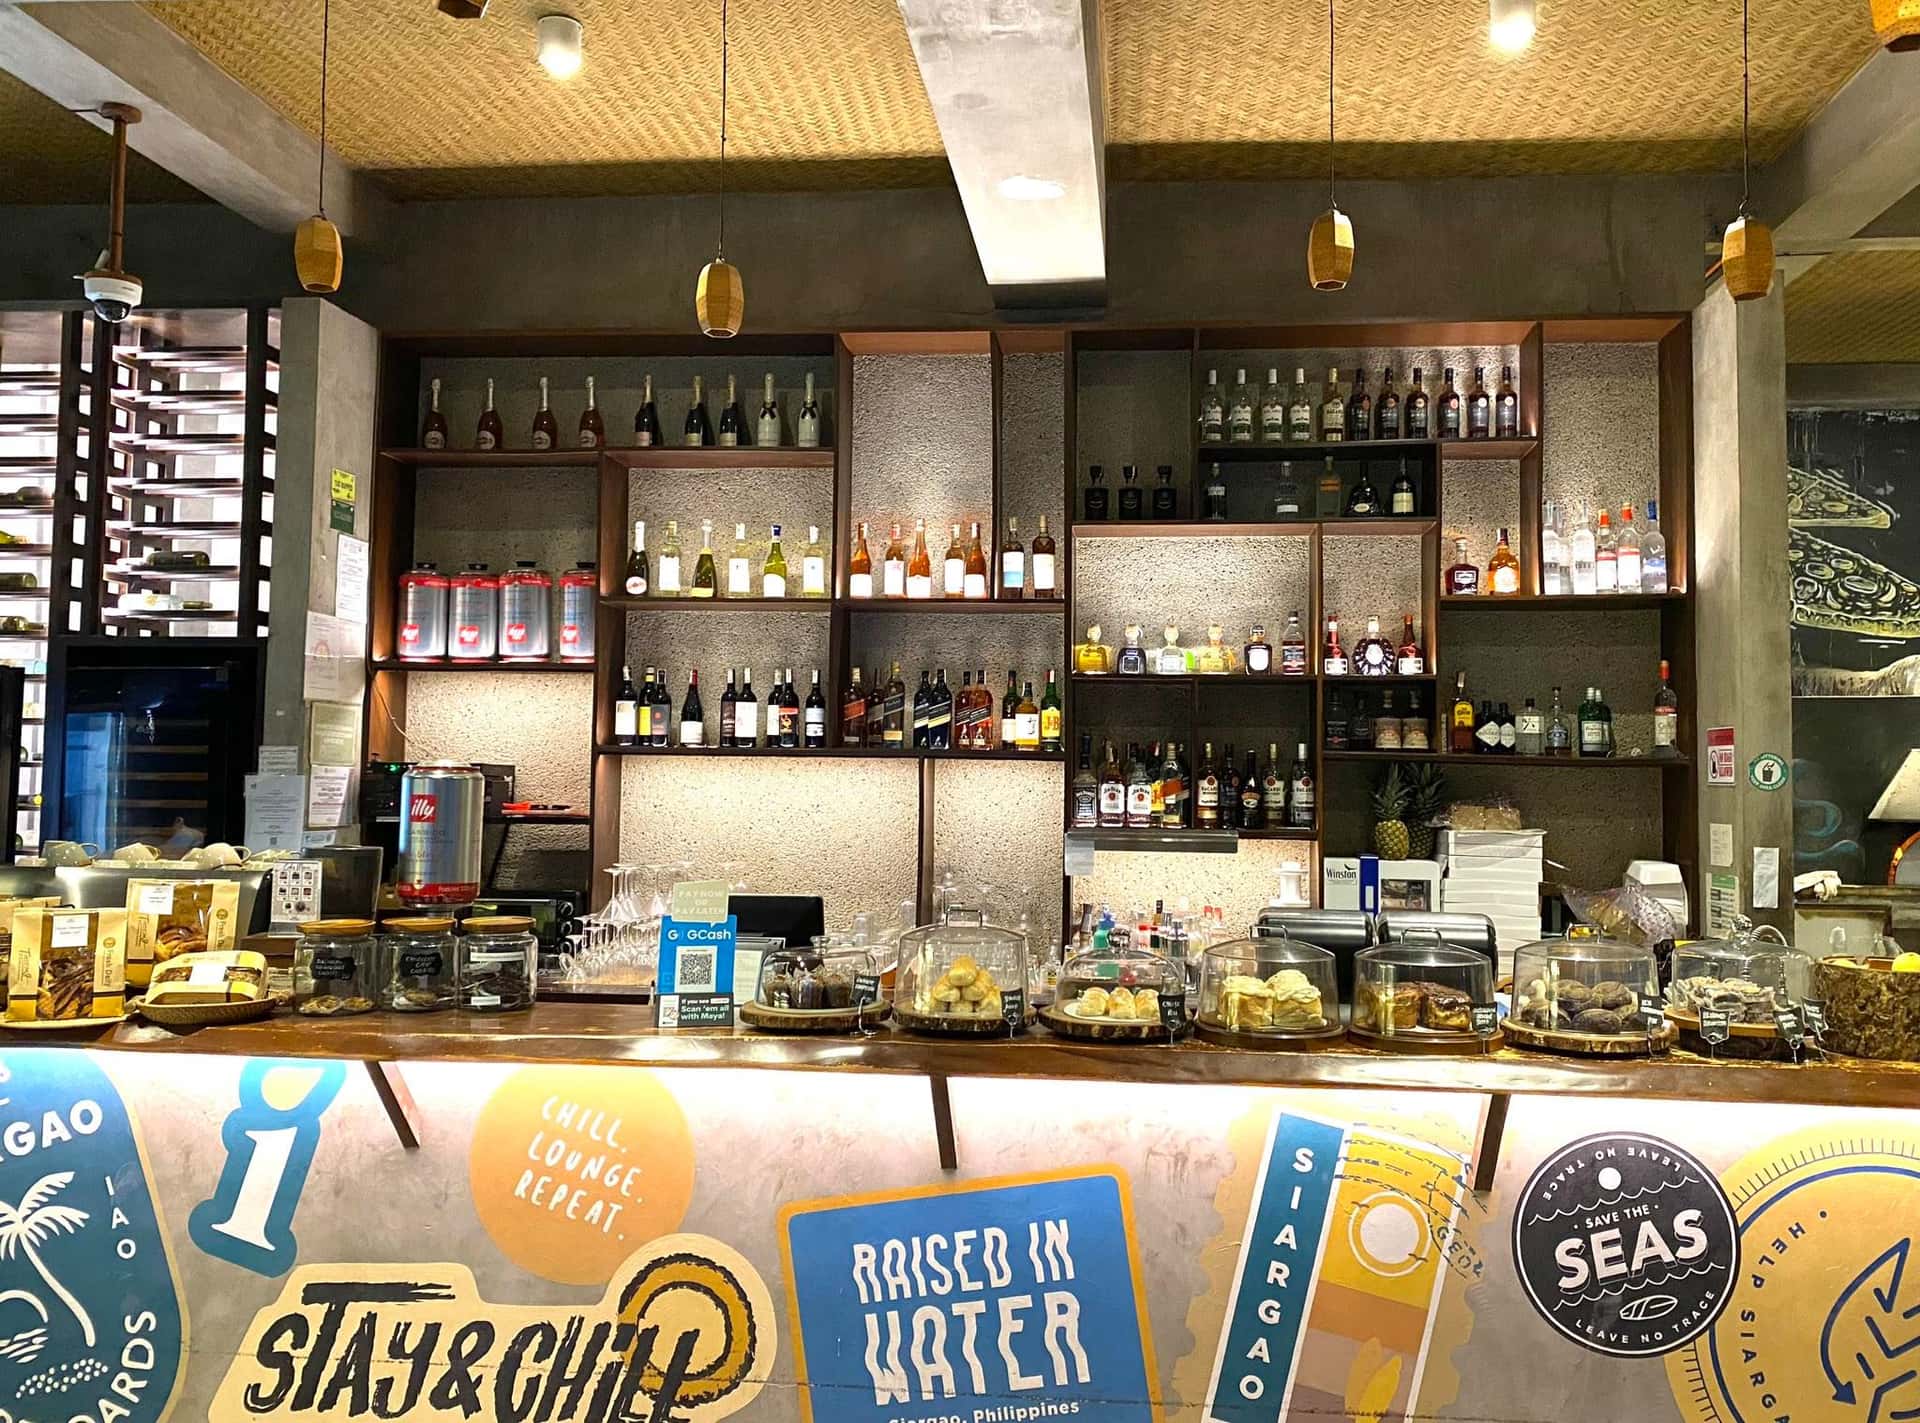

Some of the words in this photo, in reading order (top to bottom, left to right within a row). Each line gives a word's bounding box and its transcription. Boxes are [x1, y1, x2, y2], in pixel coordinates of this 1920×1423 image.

[411, 799, 435, 820] illy
[1326, 868, 1357, 879] Winston
[687, 929, 732, 940] GCash
[700, 1012, 725, 1020] Maya!
[0, 1099, 104, 1163] GAO
[542, 1095, 628, 1153] CHILL.
[527, 1131, 644, 1203] LOUNGE.
[1542, 1159, 1585, 1200] TRACE
[1595, 1147, 1616, 1160] NO
[1627, 1147, 1681, 1172] LEAVE
[513, 1170, 626, 1241] REPEAT.
[1585, 1209, 1620, 1229] SAVE
[1625, 1204, 1650, 1219] THE
[852, 1227, 1013, 1304] RAISED
[1028, 1218, 1075, 1283] IN
[1239, 1148, 1315, 1400] SIARGAO
[1555, 1209, 1709, 1293] SEAS
[1751, 1221, 1807, 1289] HELP
[1575, 1320, 1631, 1344] LEAVE
[1641, 1332, 1664, 1344] NO
[1672, 1289, 1716, 1335] TRACE
[864, 1290, 1091, 1405] WATER
[973, 1402, 1080, 1423] Philippines
